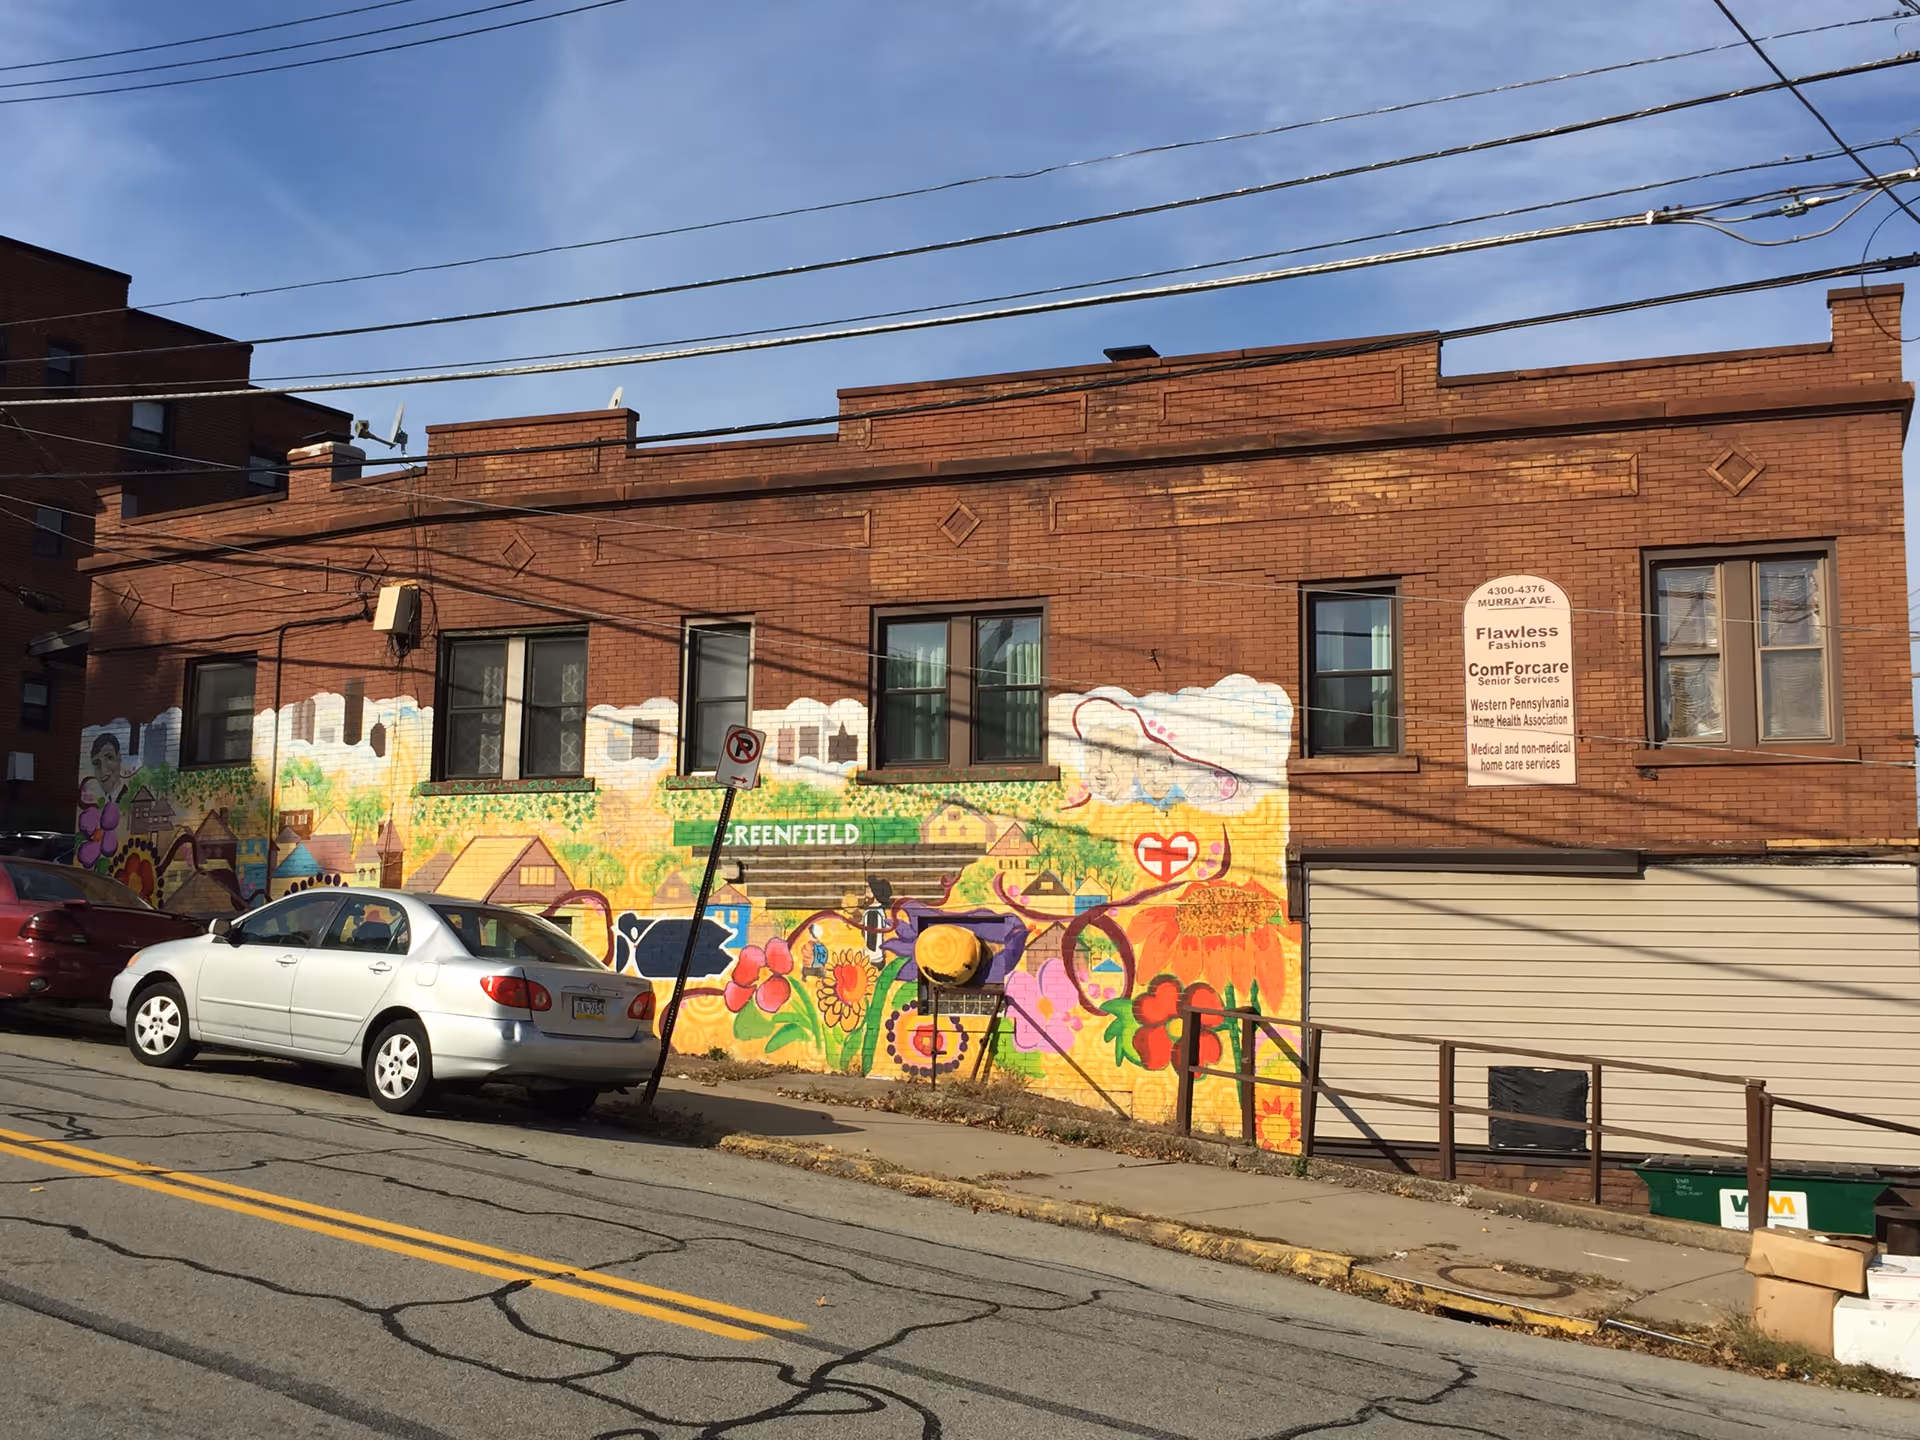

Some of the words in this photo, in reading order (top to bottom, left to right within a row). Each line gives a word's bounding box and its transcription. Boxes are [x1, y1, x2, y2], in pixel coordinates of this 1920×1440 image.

[1487, 585, 1545, 595] 4300-4376
[1477, 597, 1527, 607] MURRAY
[1529, 596, 1556, 605] AVE.
[1476, 625, 1559, 640] Flawless
[1488, 639, 1547, 650] Fashions
[1468, 661, 1569, 677] ComForcare
[1478, 676, 1511, 686] Senior
[1514, 675, 1560, 685] Services
[1470, 699, 1508, 711] Western
[1510, 696, 1569, 712] Pennsylvania
[1473, 715, 1495, 727] Home
[1496, 714, 1522, 727] Health
[1523, 713, 1568, 726] Association
[1471, 742, 1502, 755] Medical
[1504, 742, 1519, 754] and
[1521, 740, 1571, 754] non-medical
[1480, 758, 1503, 771] home
[1505, 761, 1523, 770] care
[1525, 757, 1561, 770] services
[714, 822, 860, 846] GREENFIELD
